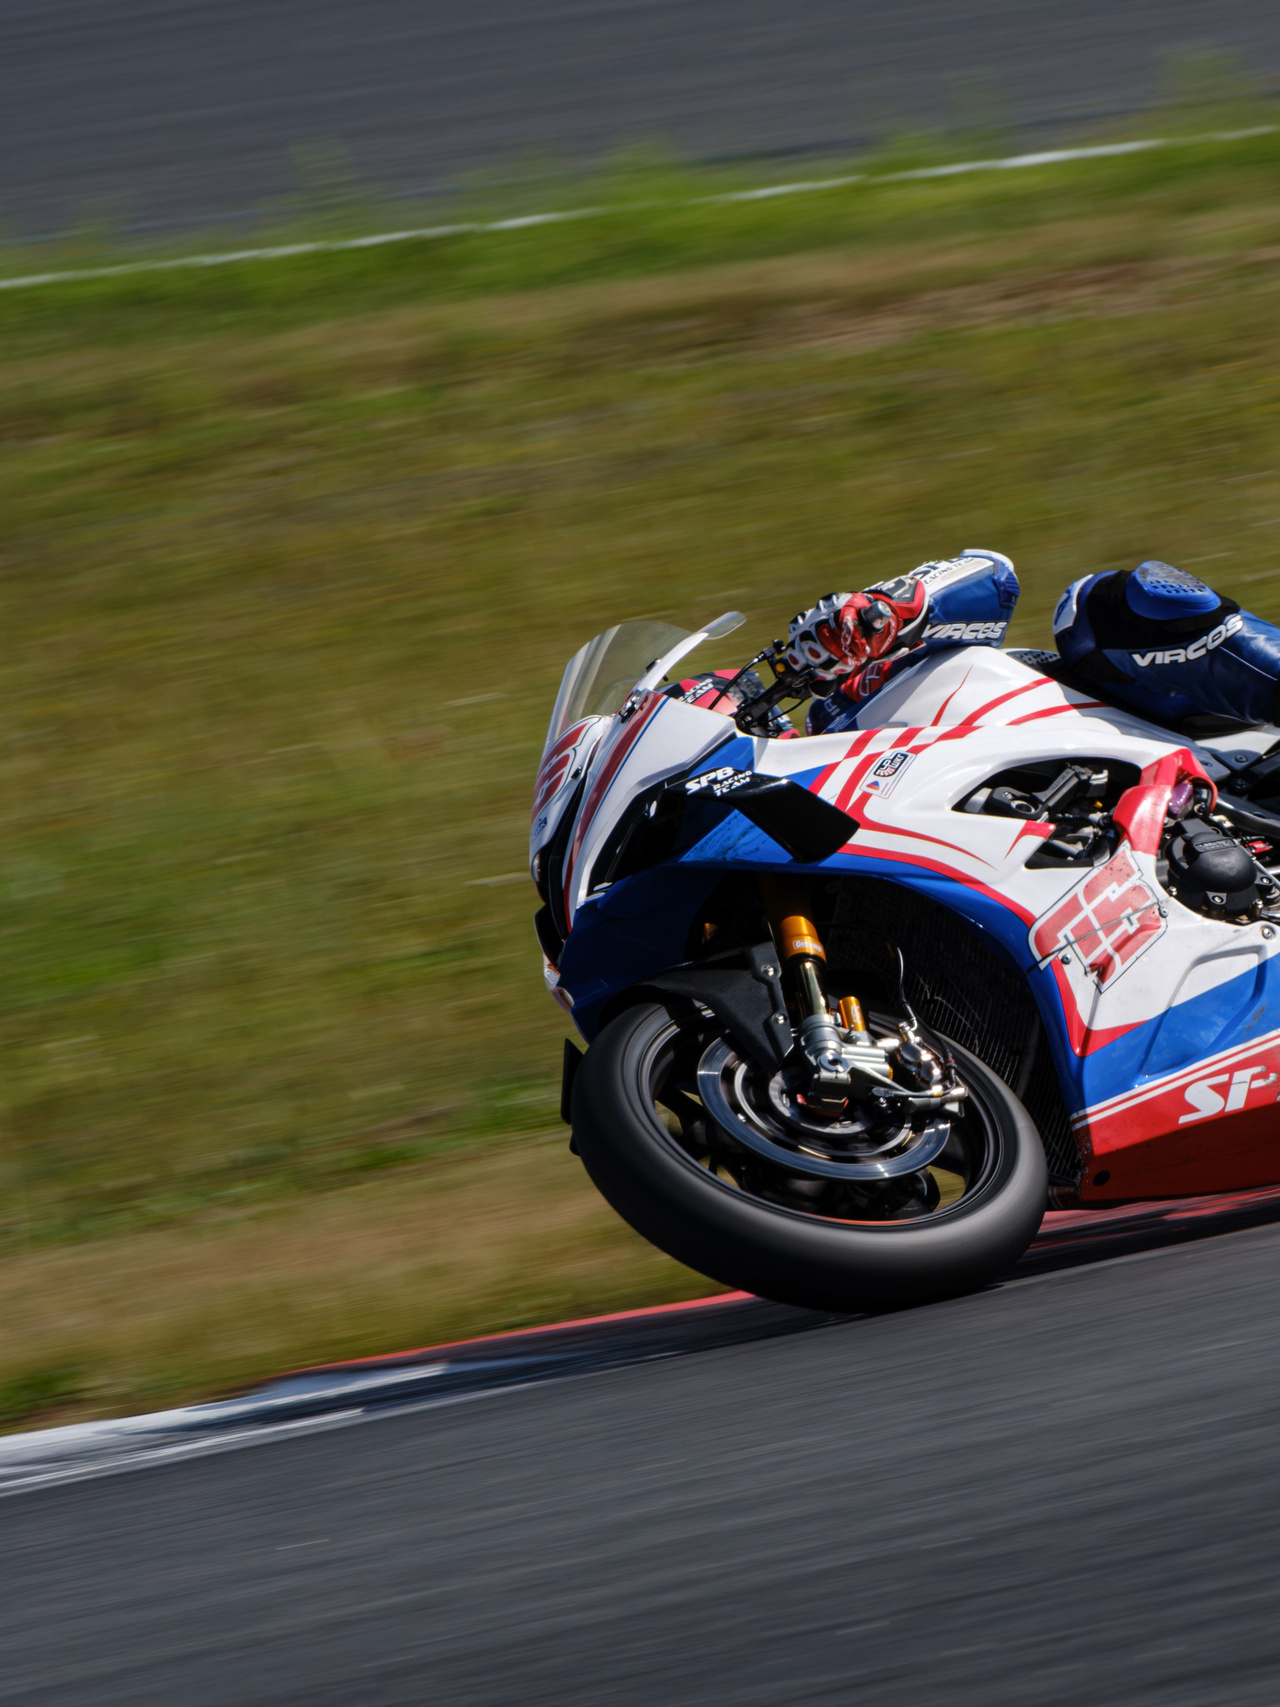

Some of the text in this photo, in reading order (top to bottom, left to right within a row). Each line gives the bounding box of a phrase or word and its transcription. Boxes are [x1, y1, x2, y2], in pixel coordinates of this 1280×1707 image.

[921, 621, 1008, 640] VIRCOS
[1131, 613, 1244, 667] VIRCOS
[684, 766, 735, 796] SPB
[713, 770, 753, 791] RACING
[714, 776, 751, 797] TEAM
